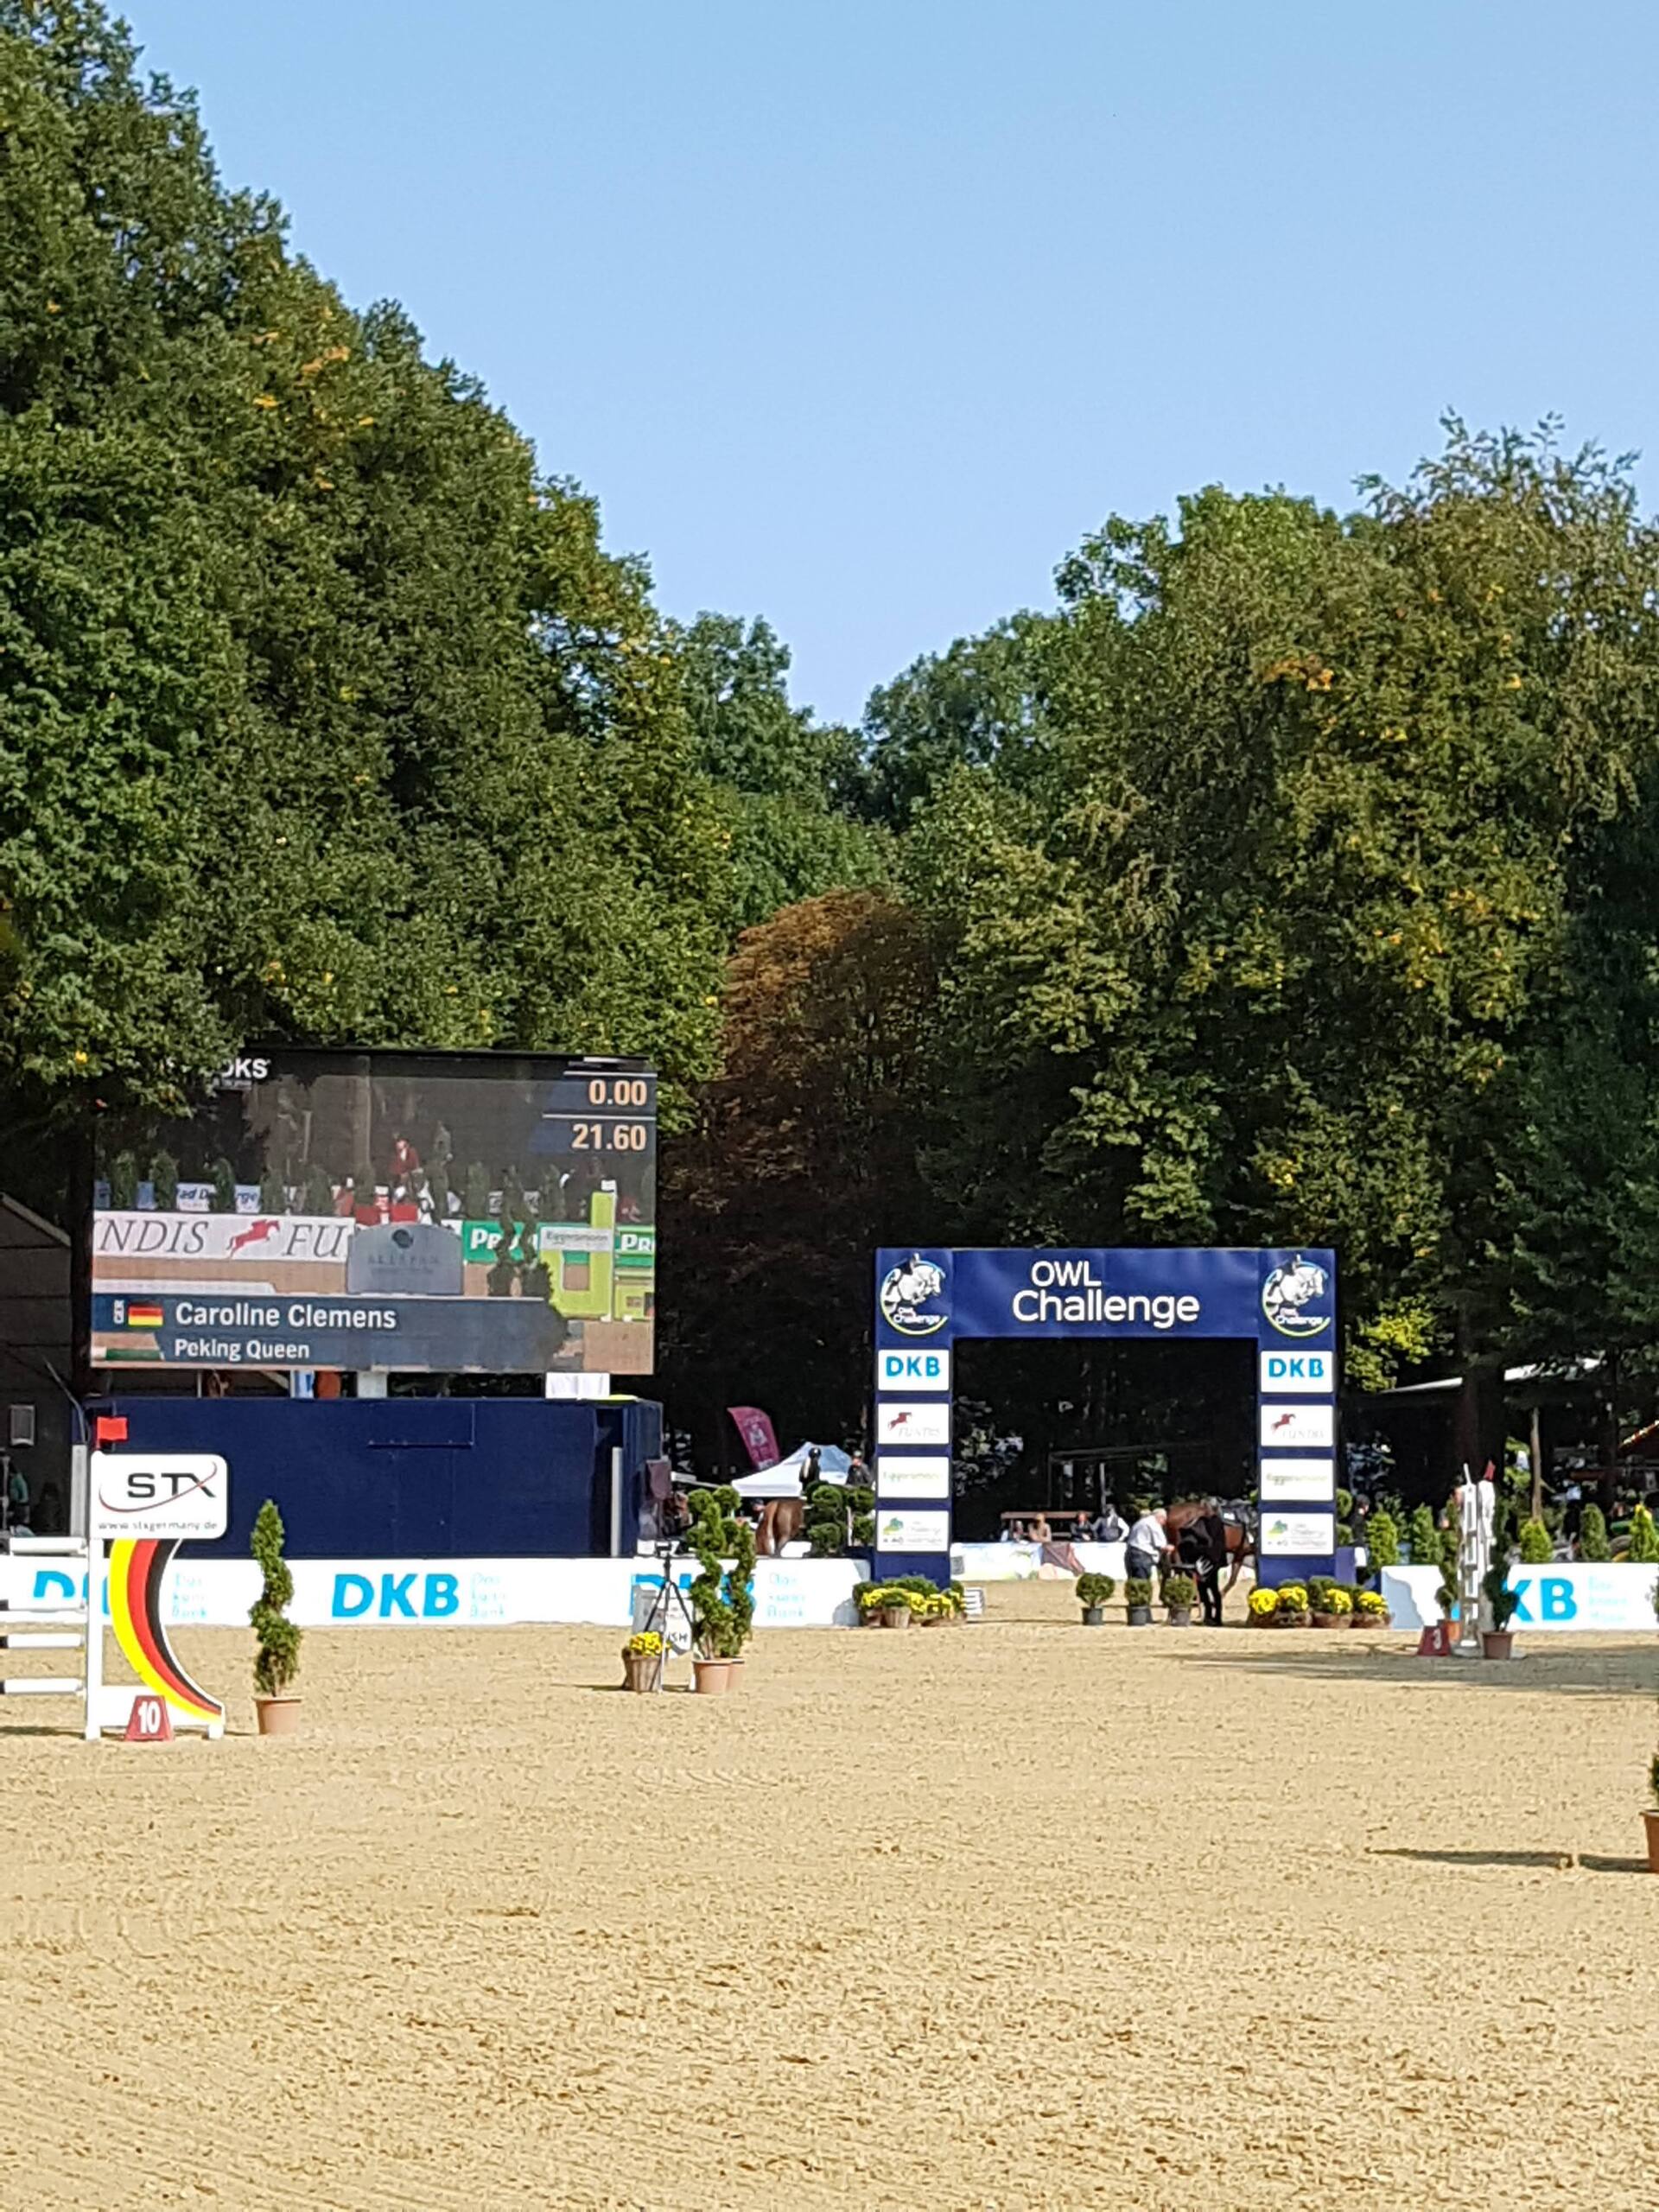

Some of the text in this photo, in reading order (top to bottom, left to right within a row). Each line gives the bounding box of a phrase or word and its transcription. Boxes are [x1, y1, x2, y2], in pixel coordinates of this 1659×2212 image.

[588, 1079, 647, 1105] 0.00
[571, 1123, 646, 1150] 21.60
[94, 1219, 209, 1253] NDIS
[1031, 1261, 1102, 1287] OWL
[175, 1302, 397, 1328] Caroline Clemens
[1012, 1288, 1200, 1329] Challenge
[175, 1338, 309, 1360] Peking Queen
[886, 1356, 940, 1376] DKB
[1268, 1357, 1324, 1377] DKB
[332, 1573, 460, 1618] DKB
[137, 1700, 161, 1734] 10
